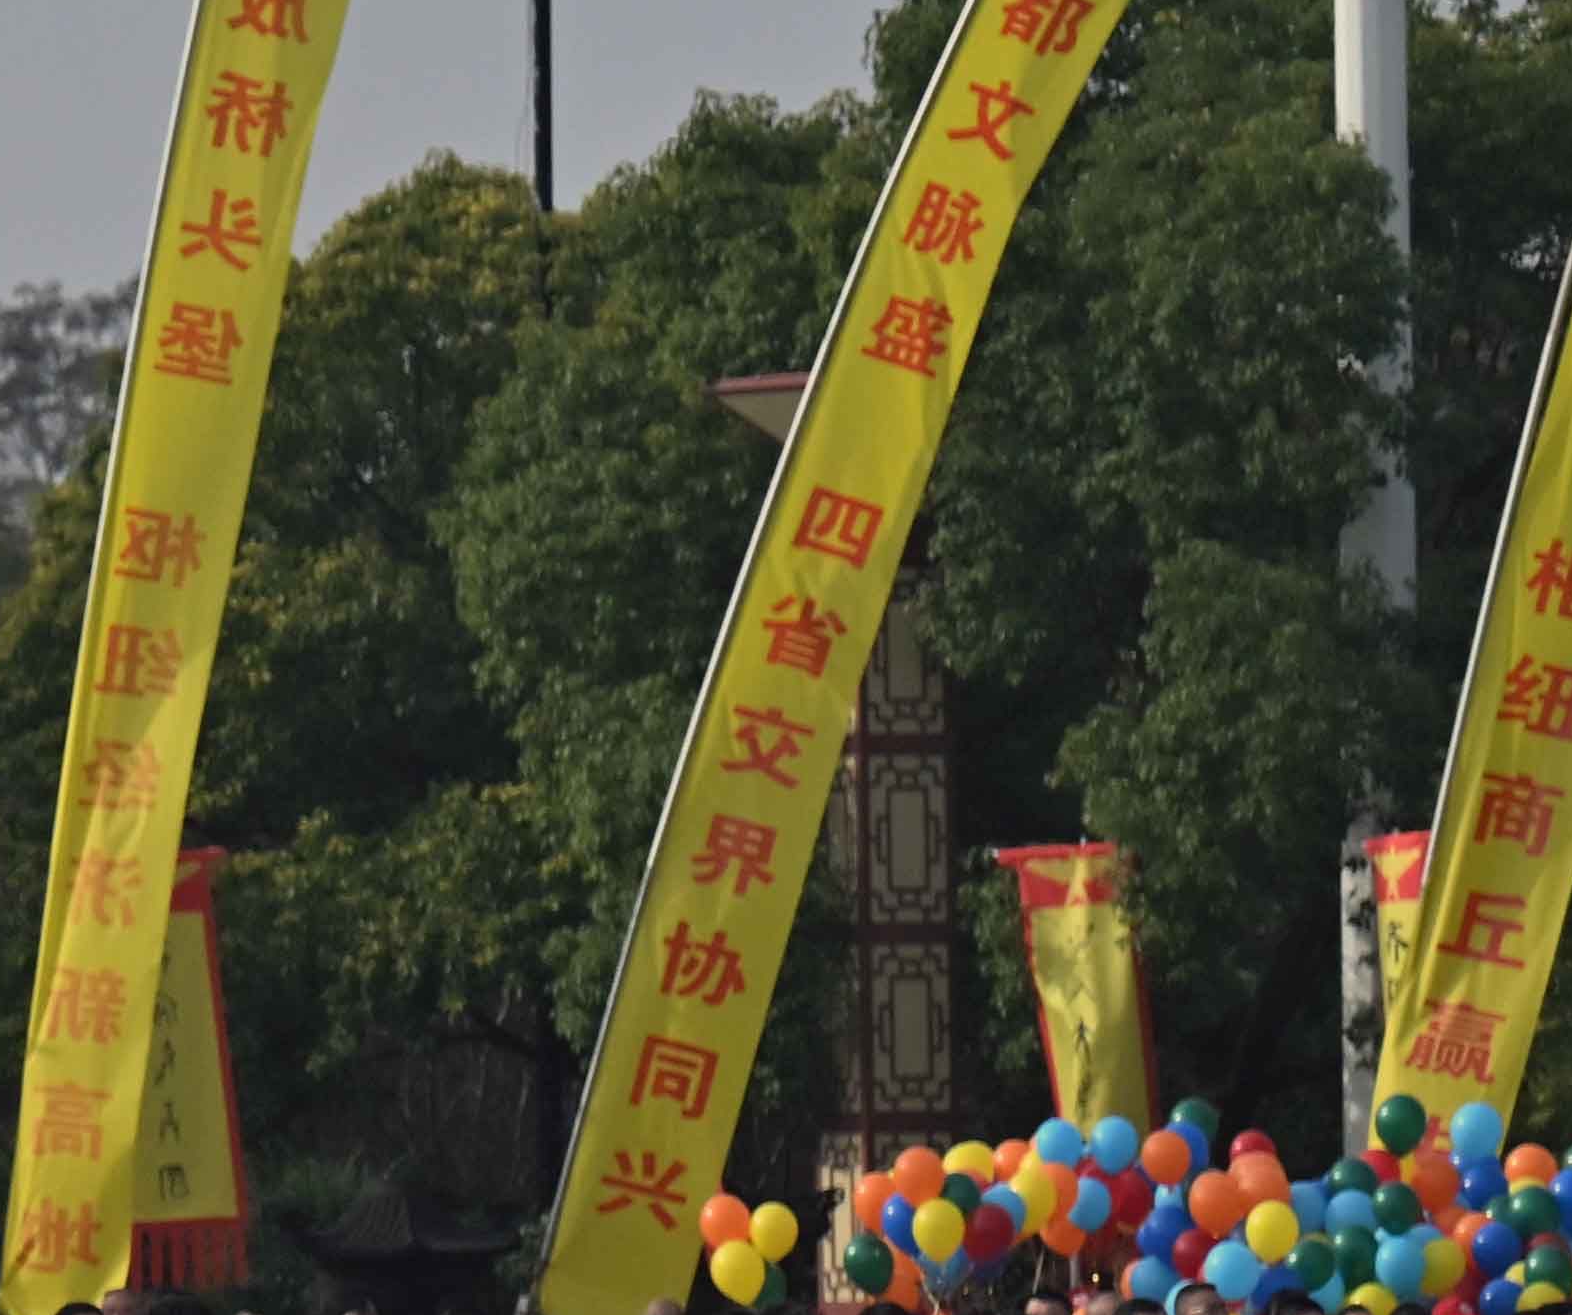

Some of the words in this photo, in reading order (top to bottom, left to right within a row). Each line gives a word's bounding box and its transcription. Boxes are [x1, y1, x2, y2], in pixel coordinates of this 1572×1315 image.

[599, 485, 883, 1230] 四省交界协同兴
